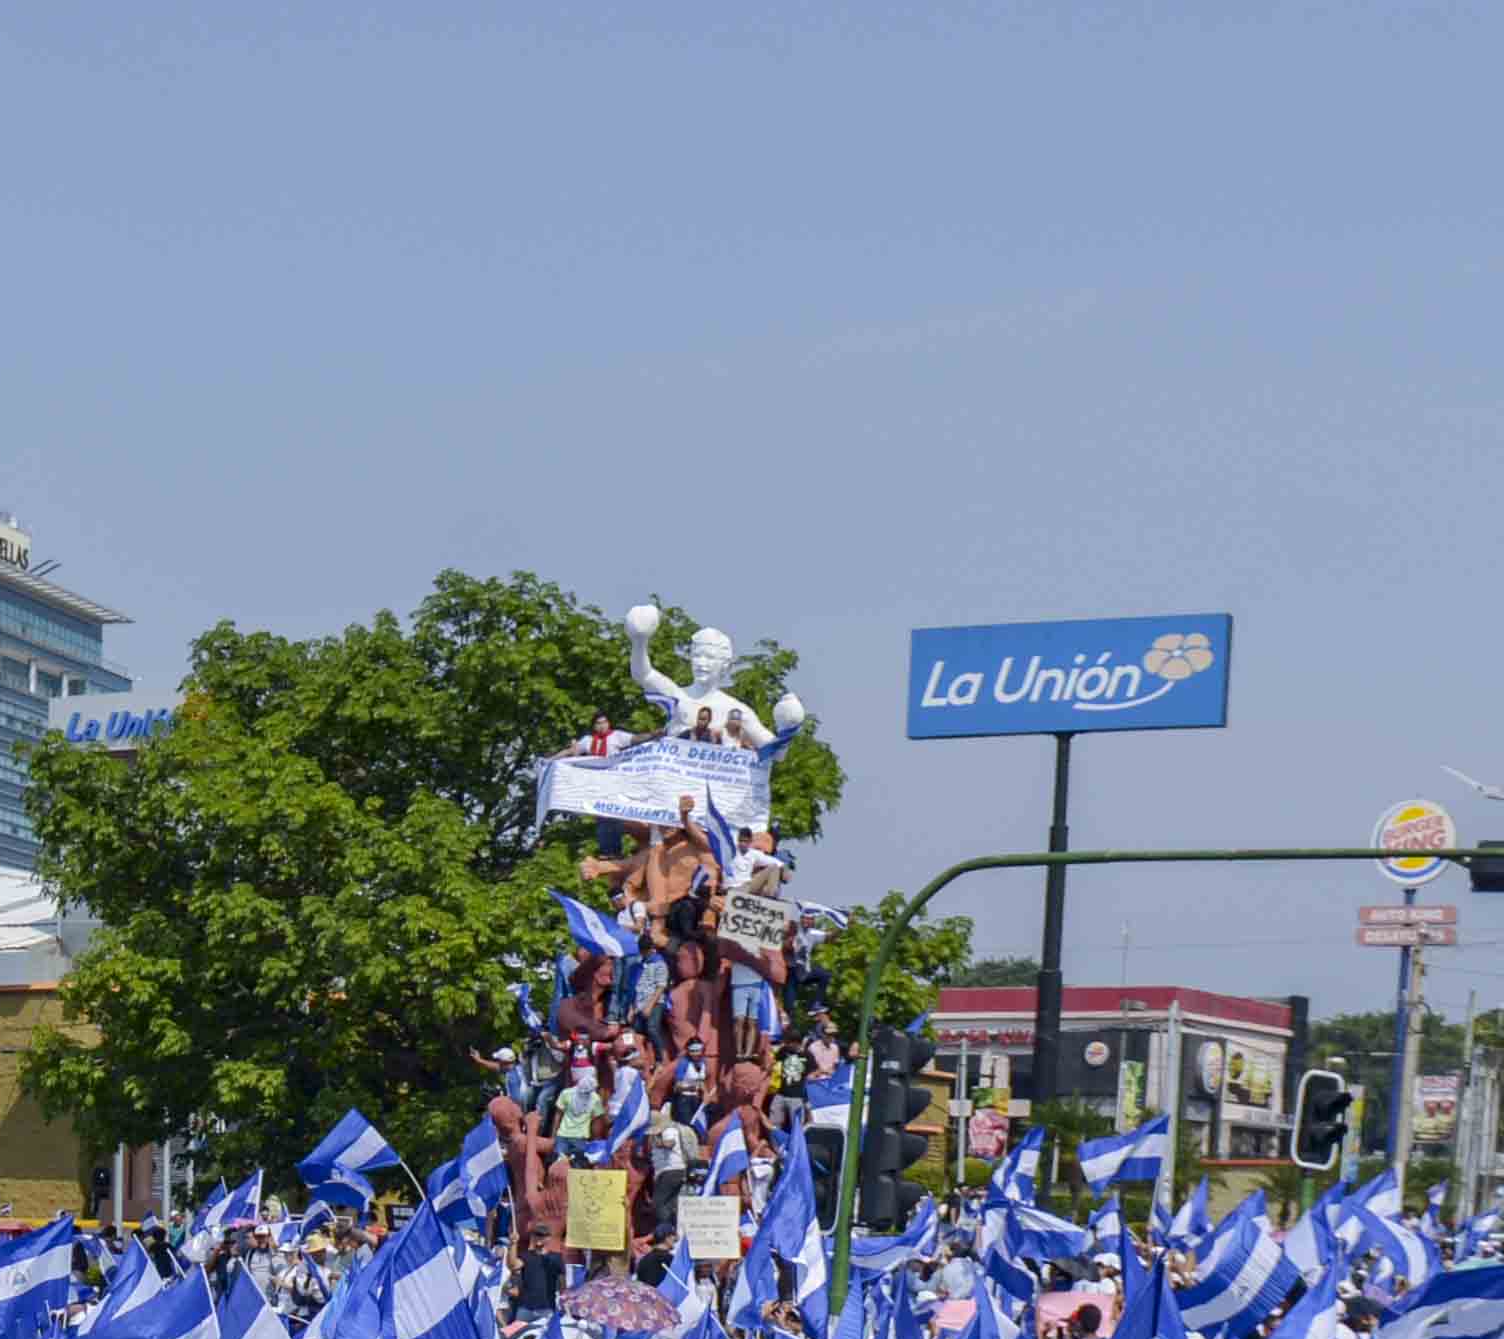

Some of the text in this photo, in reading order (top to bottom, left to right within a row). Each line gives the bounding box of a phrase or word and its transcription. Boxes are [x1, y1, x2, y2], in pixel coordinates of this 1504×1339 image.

[921, 651, 1142, 707] La Unión
[64, 711, 101, 743] La
